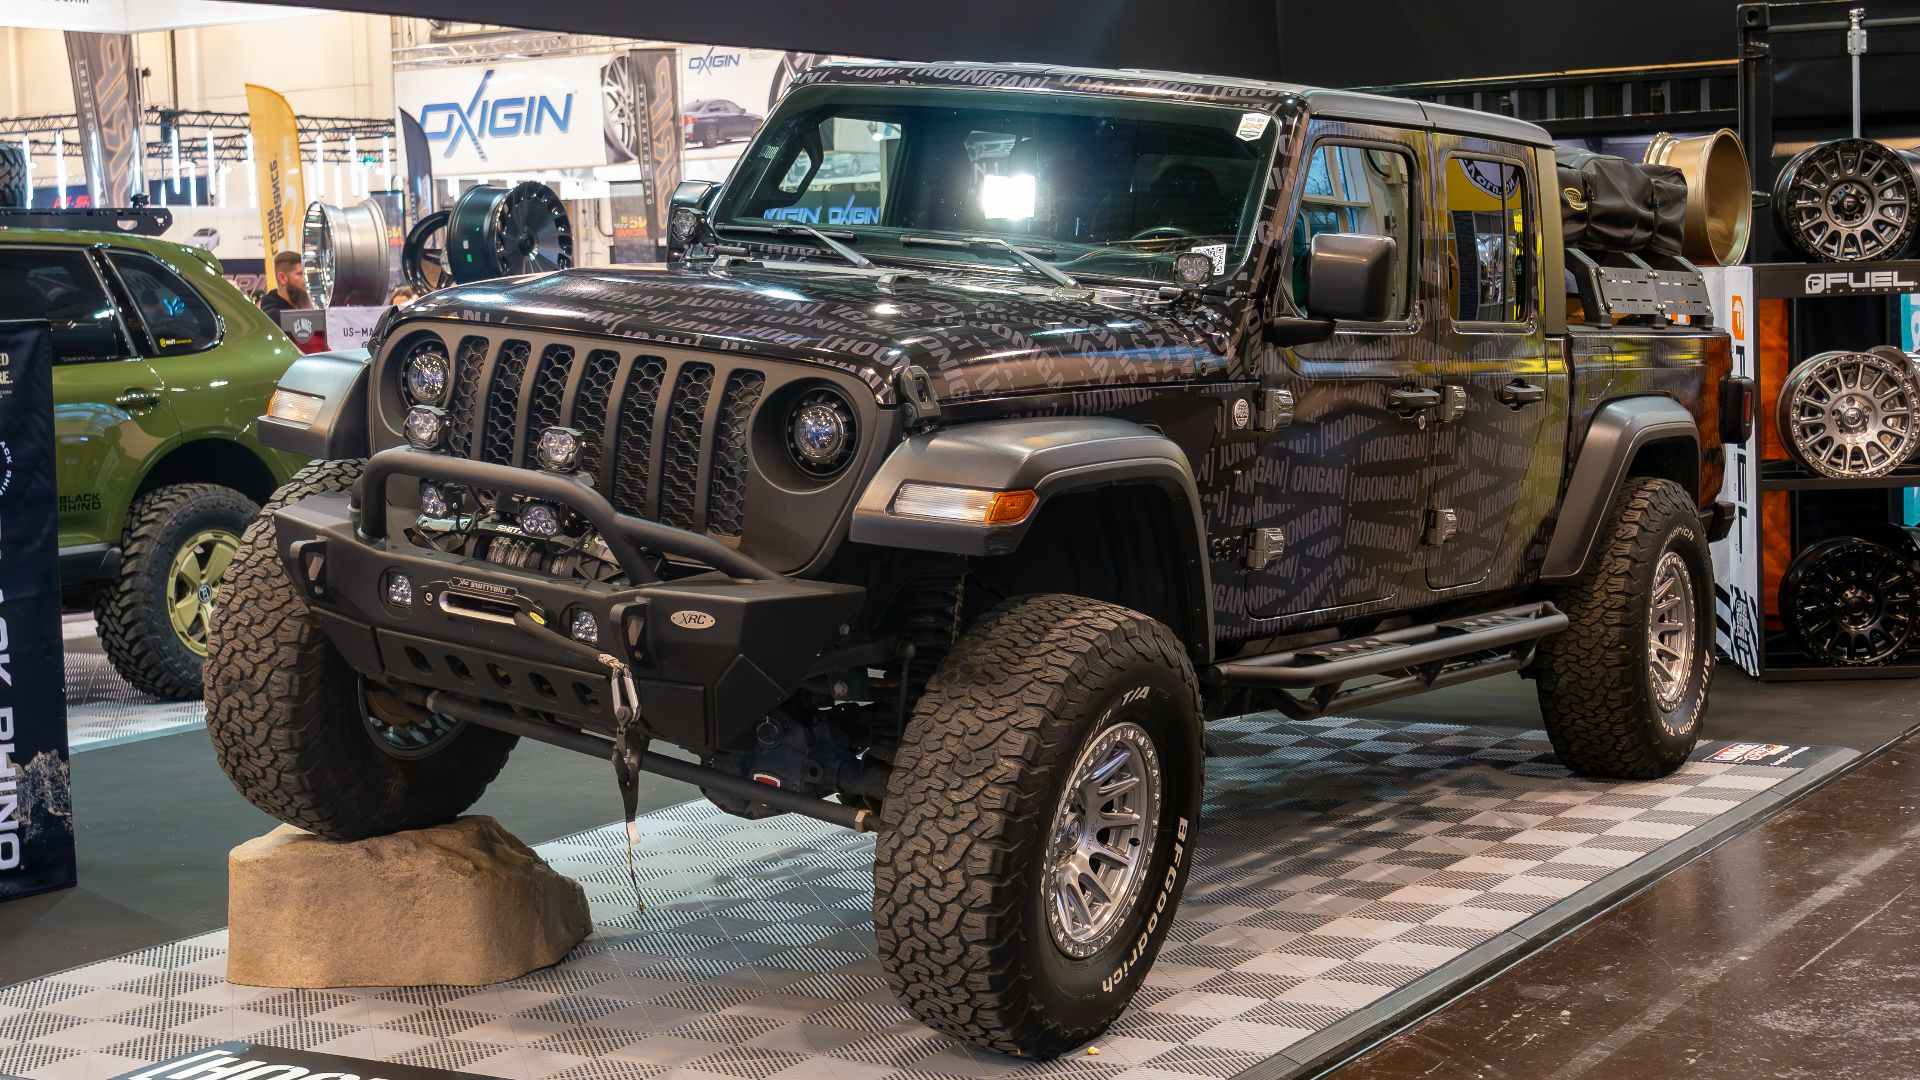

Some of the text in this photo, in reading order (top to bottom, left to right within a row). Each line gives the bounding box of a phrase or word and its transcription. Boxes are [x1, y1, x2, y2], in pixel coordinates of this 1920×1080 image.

[688, 47, 740, 75] OXIGIN
[420, 69, 573, 162] OXIGIN
[828, 194, 880, 225] OXIGIN
[1826, 271, 1915, 289] FUEL
[58, 492, 101, 503] BLACK
[58, 501, 102, 513] RHINO
[680, 611, 706, 626] XRC
[1101, 816, 1189, 993] BFGoodrich
